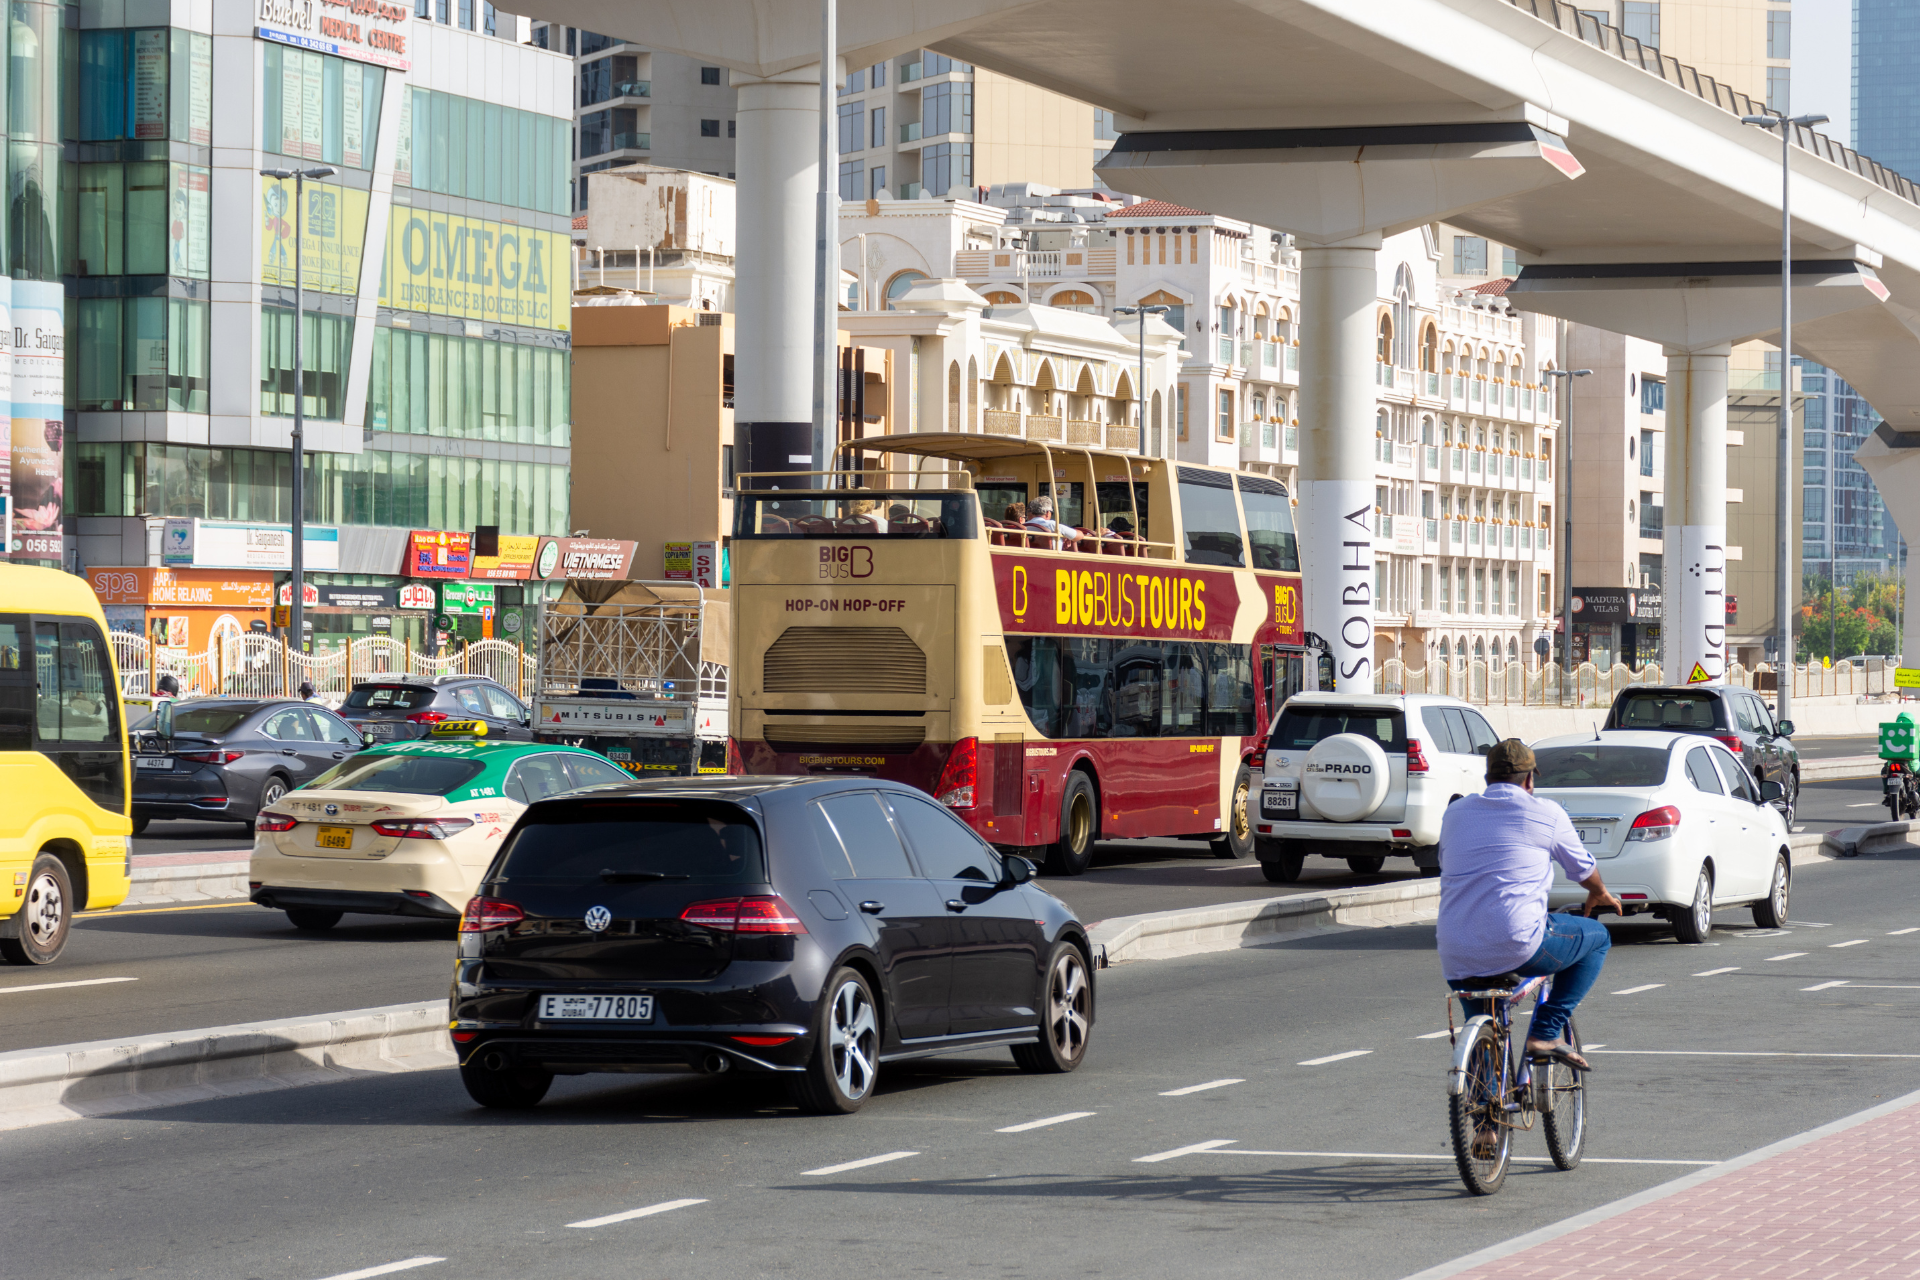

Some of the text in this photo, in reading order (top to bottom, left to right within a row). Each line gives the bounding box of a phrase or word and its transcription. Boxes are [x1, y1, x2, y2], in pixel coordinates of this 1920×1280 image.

[320, 16, 406, 54] MEDICAL CENTRE
[317, 240, 359, 258] INSURANCE
[402, 217, 547, 294] OMEGA
[301, 255, 331, 270] ROKERS
[401, 283, 548, 320] INSURANCE BROKERS LLC
[14, 327, 31, 349] Dr.
[12, 445, 48, 454] Authentic
[20, 456, 55, 466] Ayurvedic
[35, 467, 58, 478] Healing
[26, 539, 48, 552] 056
[255, 528, 285, 550] Saiganesh
[563, 552, 624, 569] VIETNAMESE
[819, 546, 849, 562] BIG
[819, 564, 849, 579] BUS
[94, 572, 138, 600] spa
[153, 572, 177, 587] HAPPY
[153, 587, 213, 603] HOME RELAXING
[445, 589, 466, 603] Grocery
[1275, 585, 1287, 604] BIG
[1341, 504, 1370, 680] SOBHA
[786, 599, 906, 612] HOP-ON HOP-OFF
[1585, 595, 1625, 604] MADURA
[1275, 605, 1287, 623] BUS
[1593, 605, 1619, 613] VILAS
[1279, 626, 1292, 635] TOURS
[561, 711, 667, 721] MITSUBISHI
[438, 722, 472, 731] TAXI
[147, 758, 165, 769] 44374
[799, 755, 886, 766] BIGBUSTOURS.COM
[1325, 763, 1371, 774] PRADO
[470, 786, 496, 797] AT 1481
[290, 803, 321, 812] AT 1481
[1267, 796, 1291, 806] 88261
[545, 997, 556, 1016] E
[562, 1008, 586, 1017] DUBAI
[592, 996, 651, 1018] 77805
